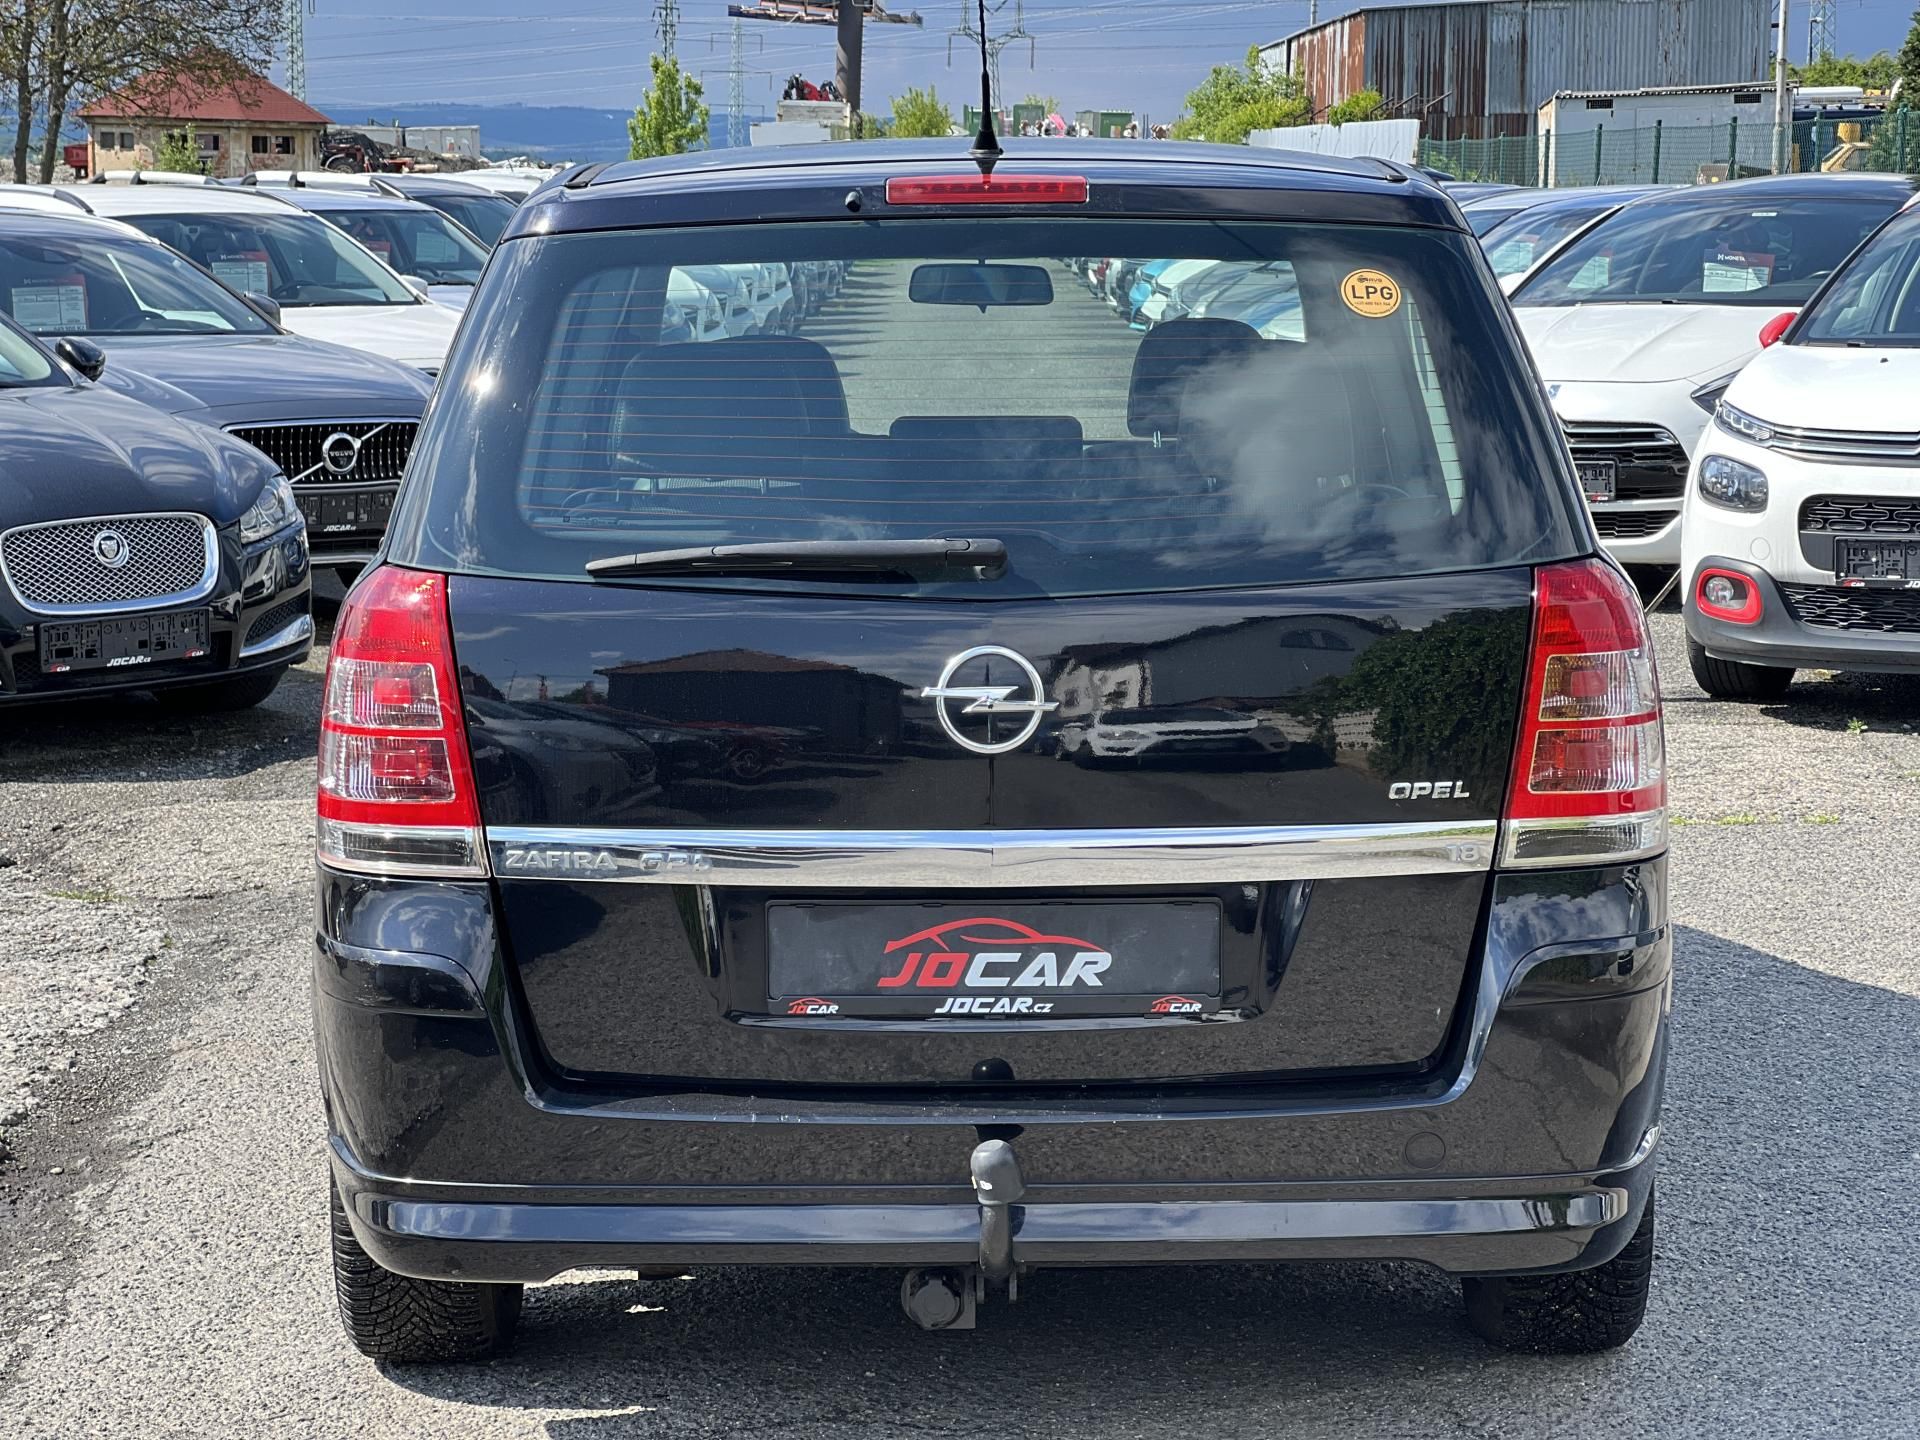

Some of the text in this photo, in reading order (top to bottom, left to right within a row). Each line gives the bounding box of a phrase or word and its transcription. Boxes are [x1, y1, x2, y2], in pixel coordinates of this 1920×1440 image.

[1351, 285, 1393, 300] LPG
[1388, 780, 1470, 800] OPEL
[505, 850, 618, 870] ZAFIRA
[877, 952, 1113, 988] JOCAR
[787, 1004, 839, 1014] JOCAR
[934, 997, 1054, 1014] JOCAR.cz
[1151, 1002, 1202, 1013] JOCAR
